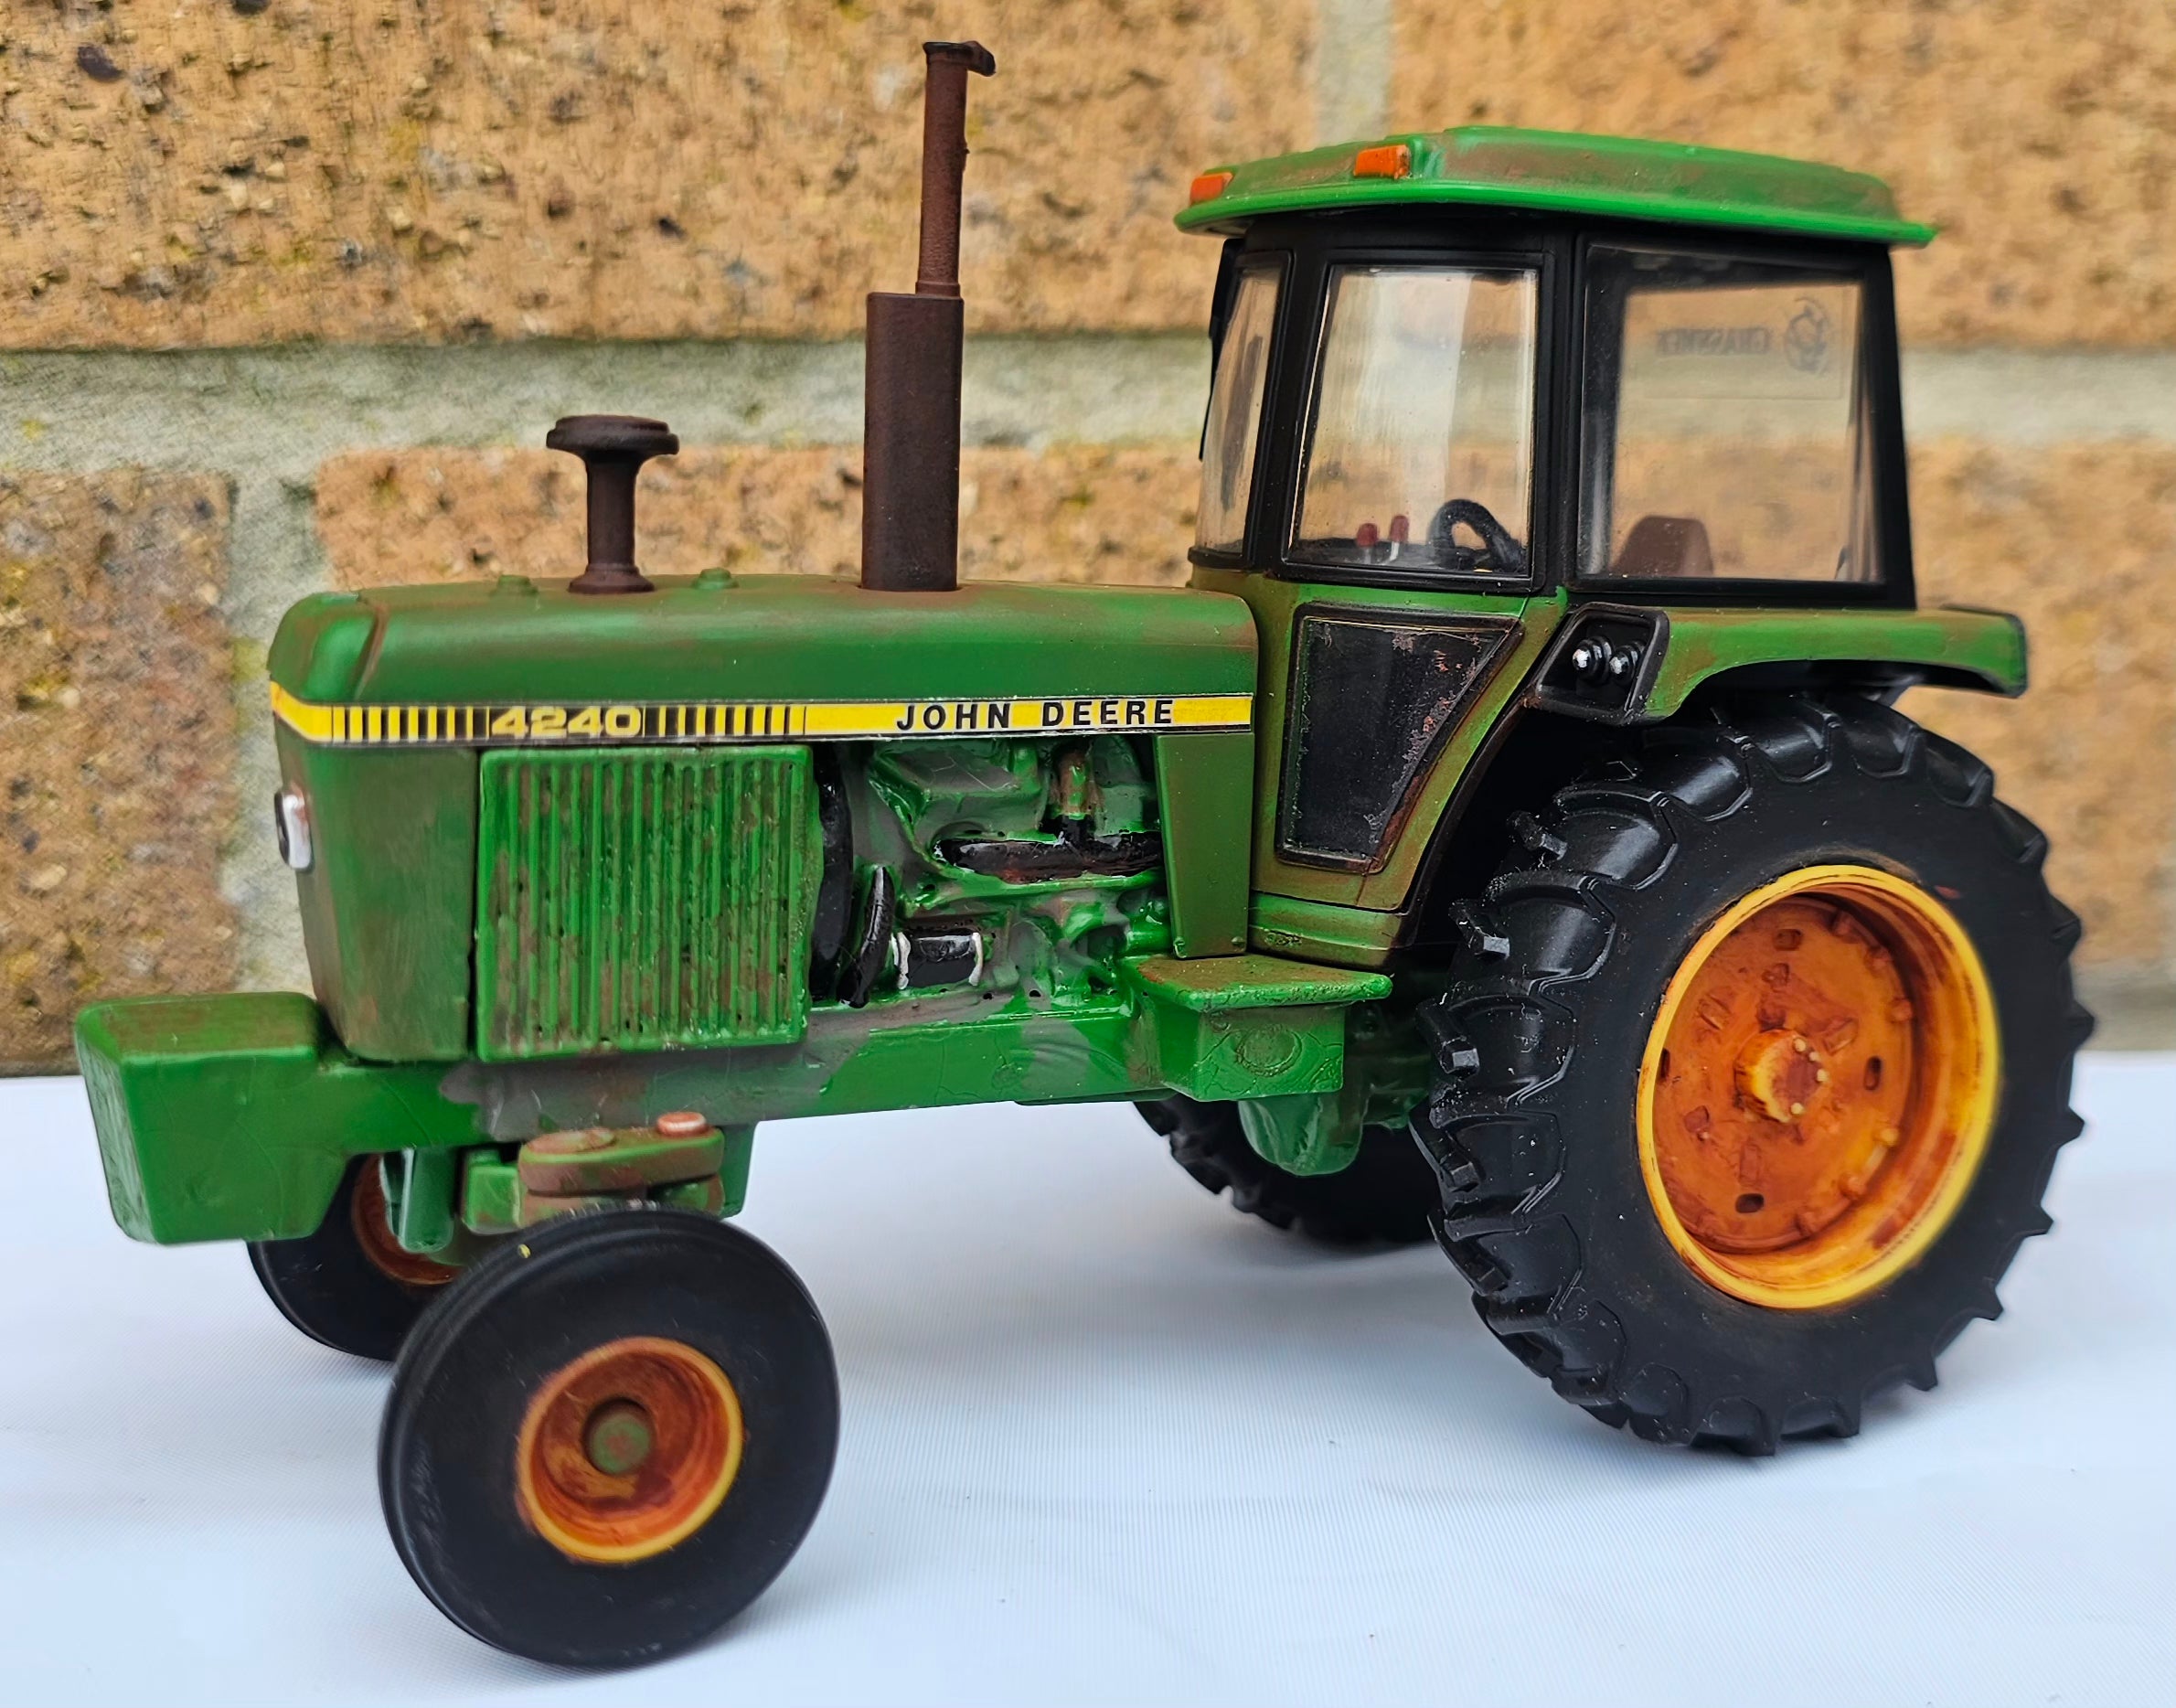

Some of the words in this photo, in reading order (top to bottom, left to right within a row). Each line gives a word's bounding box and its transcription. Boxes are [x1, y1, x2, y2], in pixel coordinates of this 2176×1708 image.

[491, 706, 642, 739] 4240
[896, 703, 1010, 731] JOHN
[1041, 699, 1173, 726] DEERE
